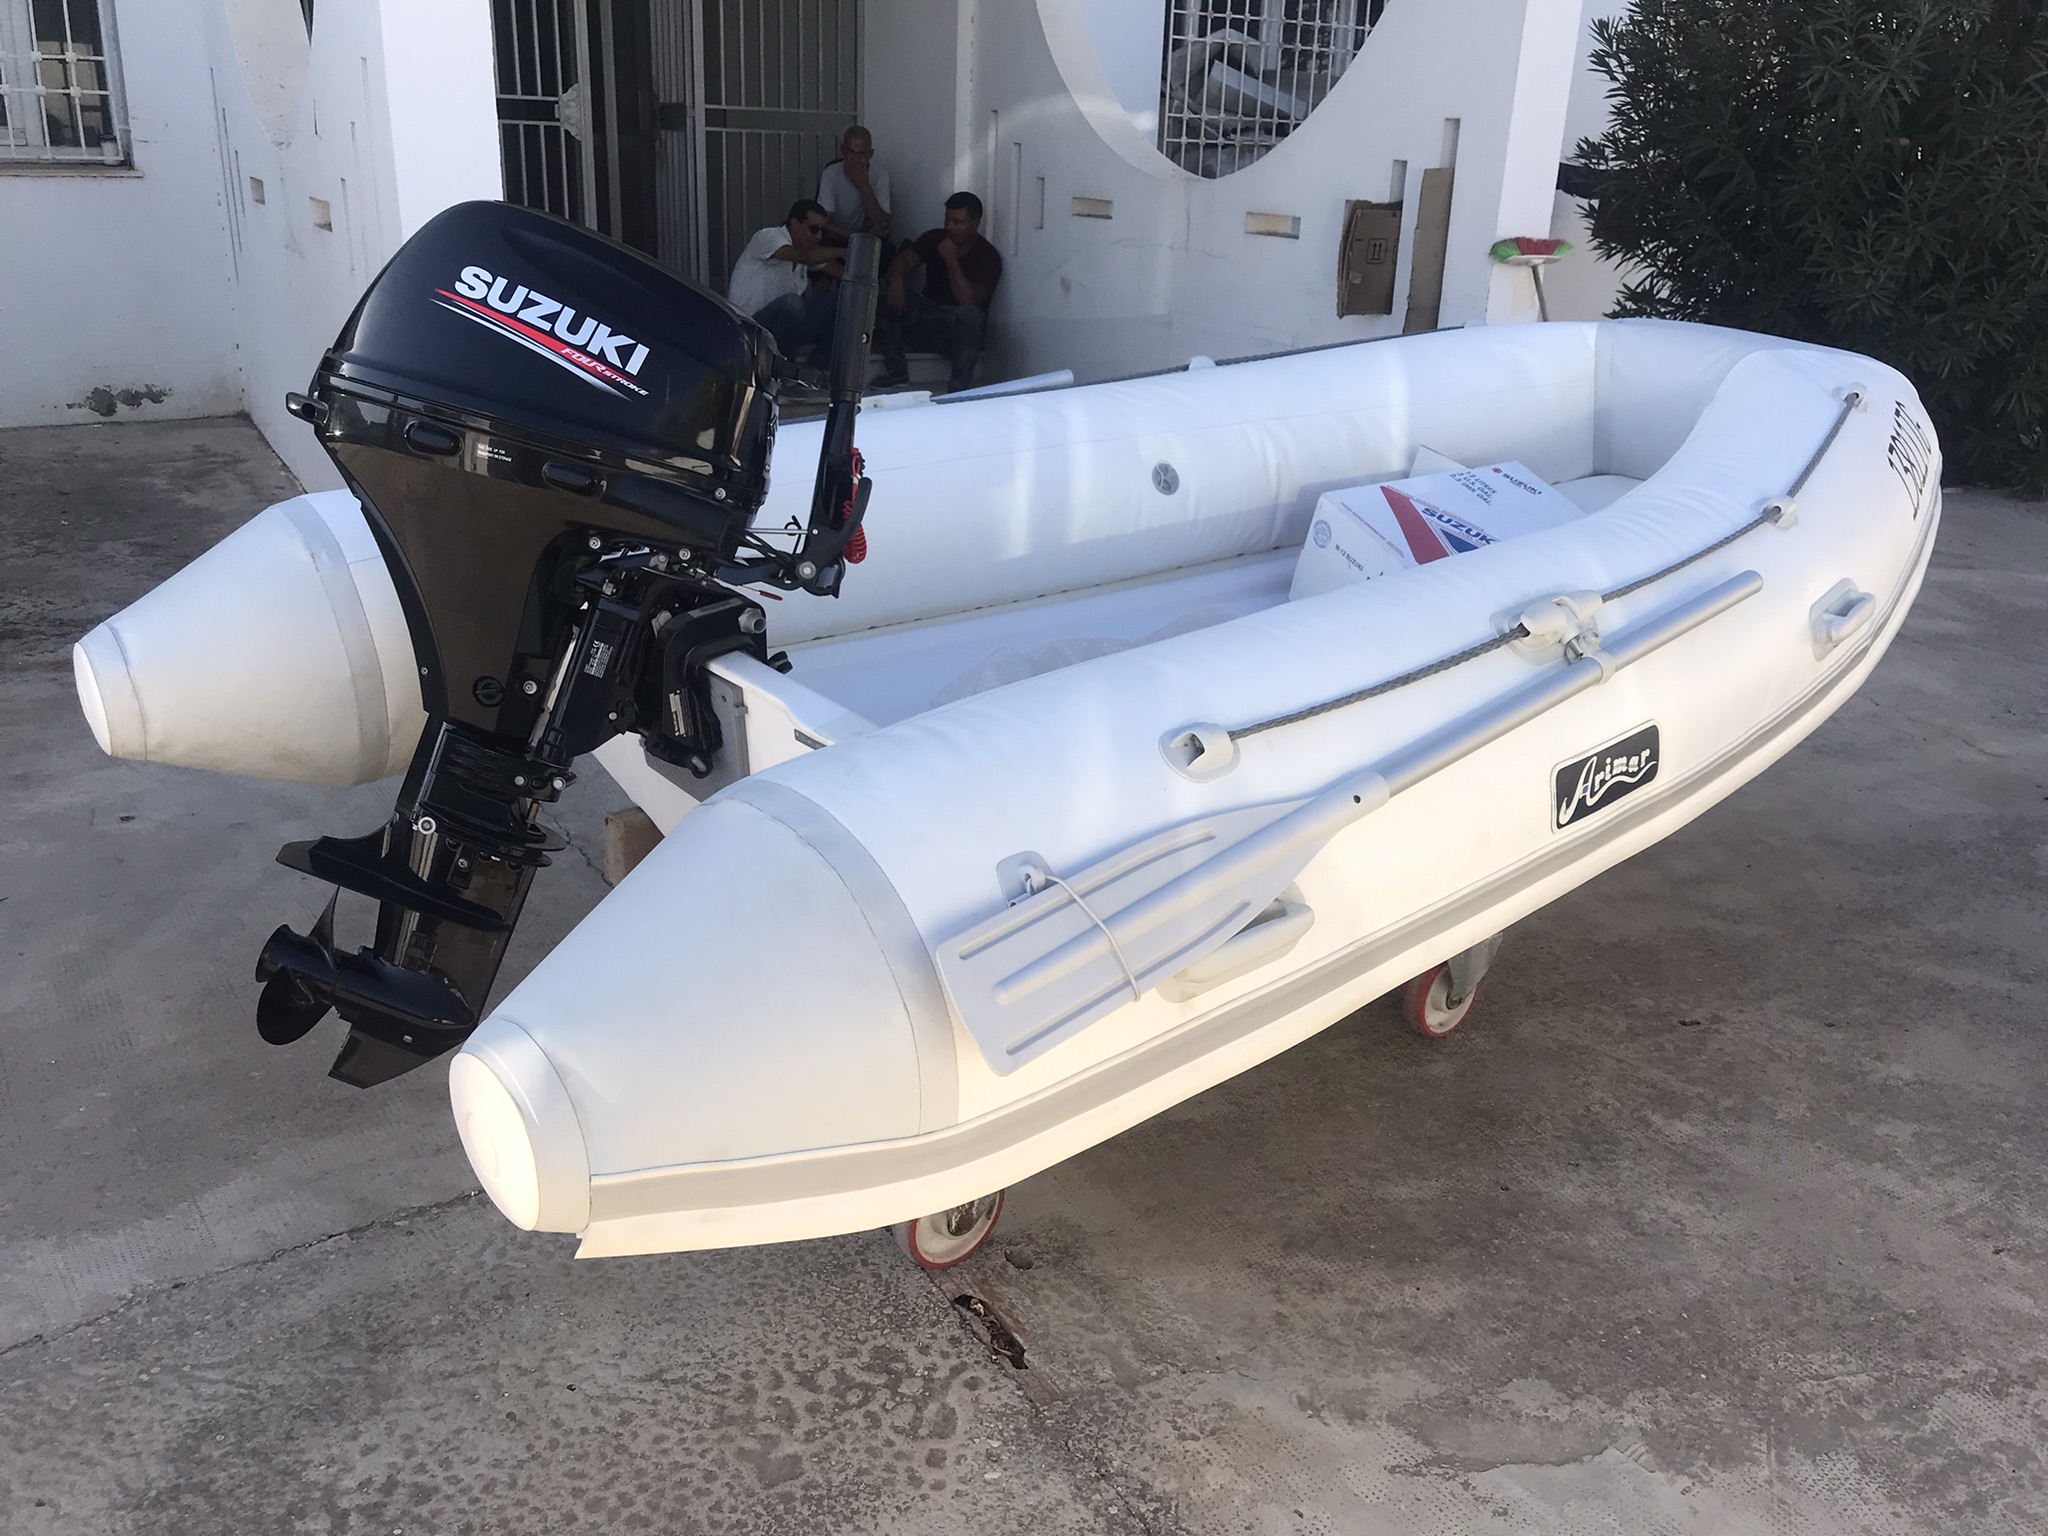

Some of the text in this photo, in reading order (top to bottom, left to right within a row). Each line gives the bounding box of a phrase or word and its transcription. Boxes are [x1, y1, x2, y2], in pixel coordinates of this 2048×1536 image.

[454, 264, 651, 377] SUZUKI
[1502, 473, 1543, 495] SUZUKI
[1421, 507, 1496, 545] SUZUK
[1345, 553, 1364, 572] SUZUKI
[1558, 748, 1658, 826] Arimar
